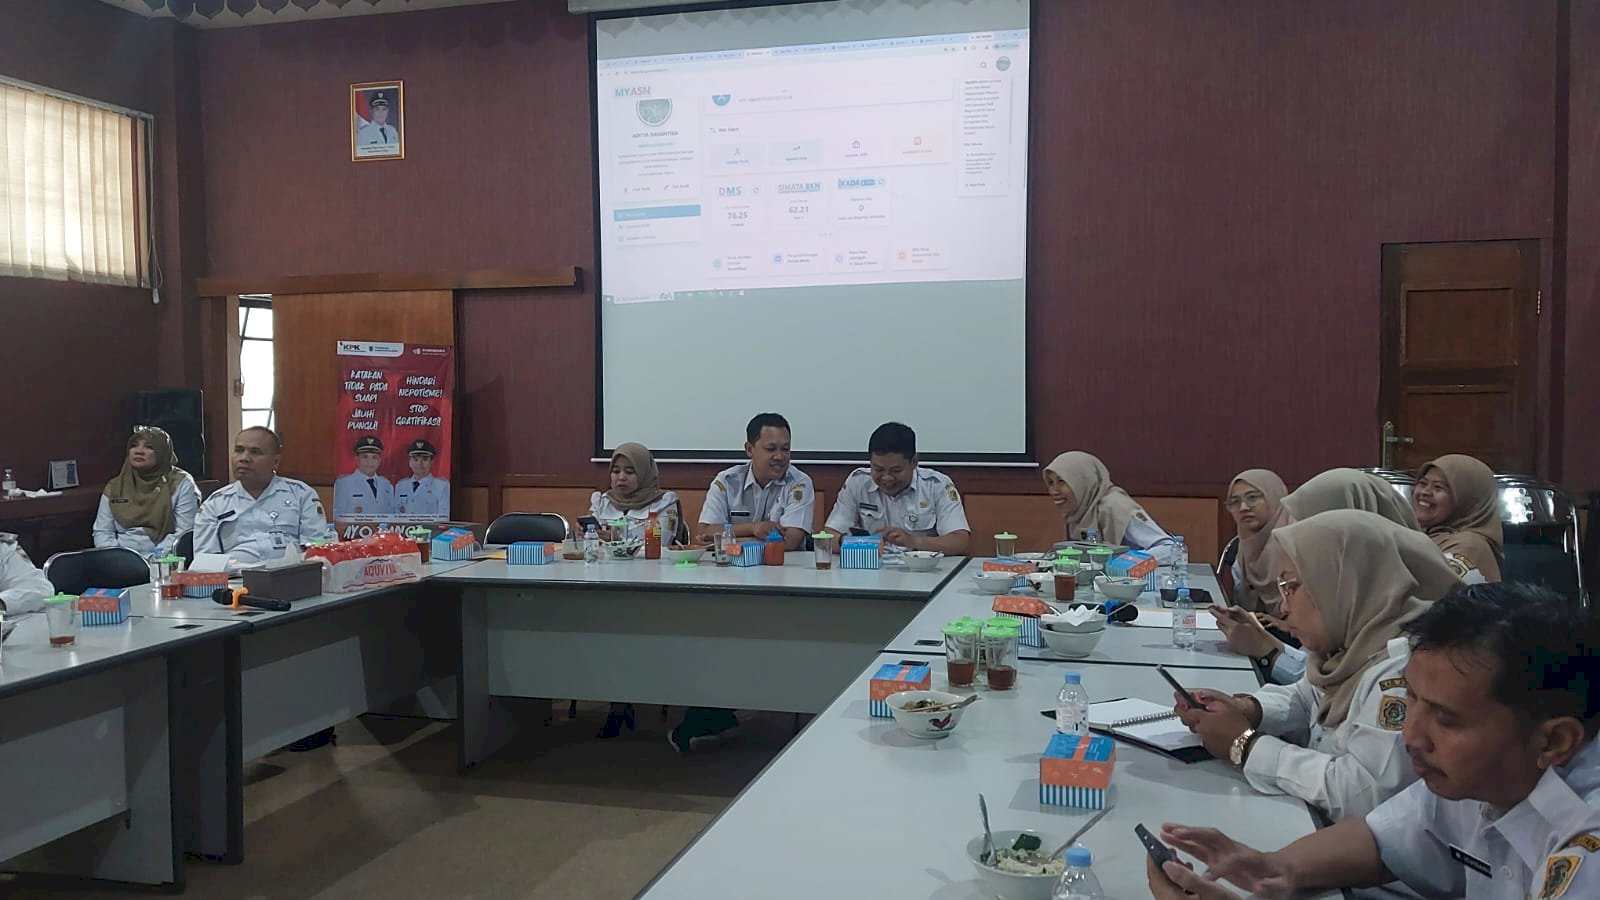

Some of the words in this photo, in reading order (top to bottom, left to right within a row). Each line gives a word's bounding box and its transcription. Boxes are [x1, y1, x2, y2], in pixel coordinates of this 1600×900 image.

[614, 86, 651, 97] MYASN
[719, 186, 742, 197] DMS
[350, 370, 383, 380] KATAKAN
[406, 375, 437, 386] HINDARI
[344, 381, 365, 391] TIDAK
[369, 382, 389, 392] PADA
[398, 387, 443, 399] NEPOTISME!
[351, 408, 376, 419] JAUHI
[408, 404, 429, 414] STOP
[343, 524, 373, 539] AYO
